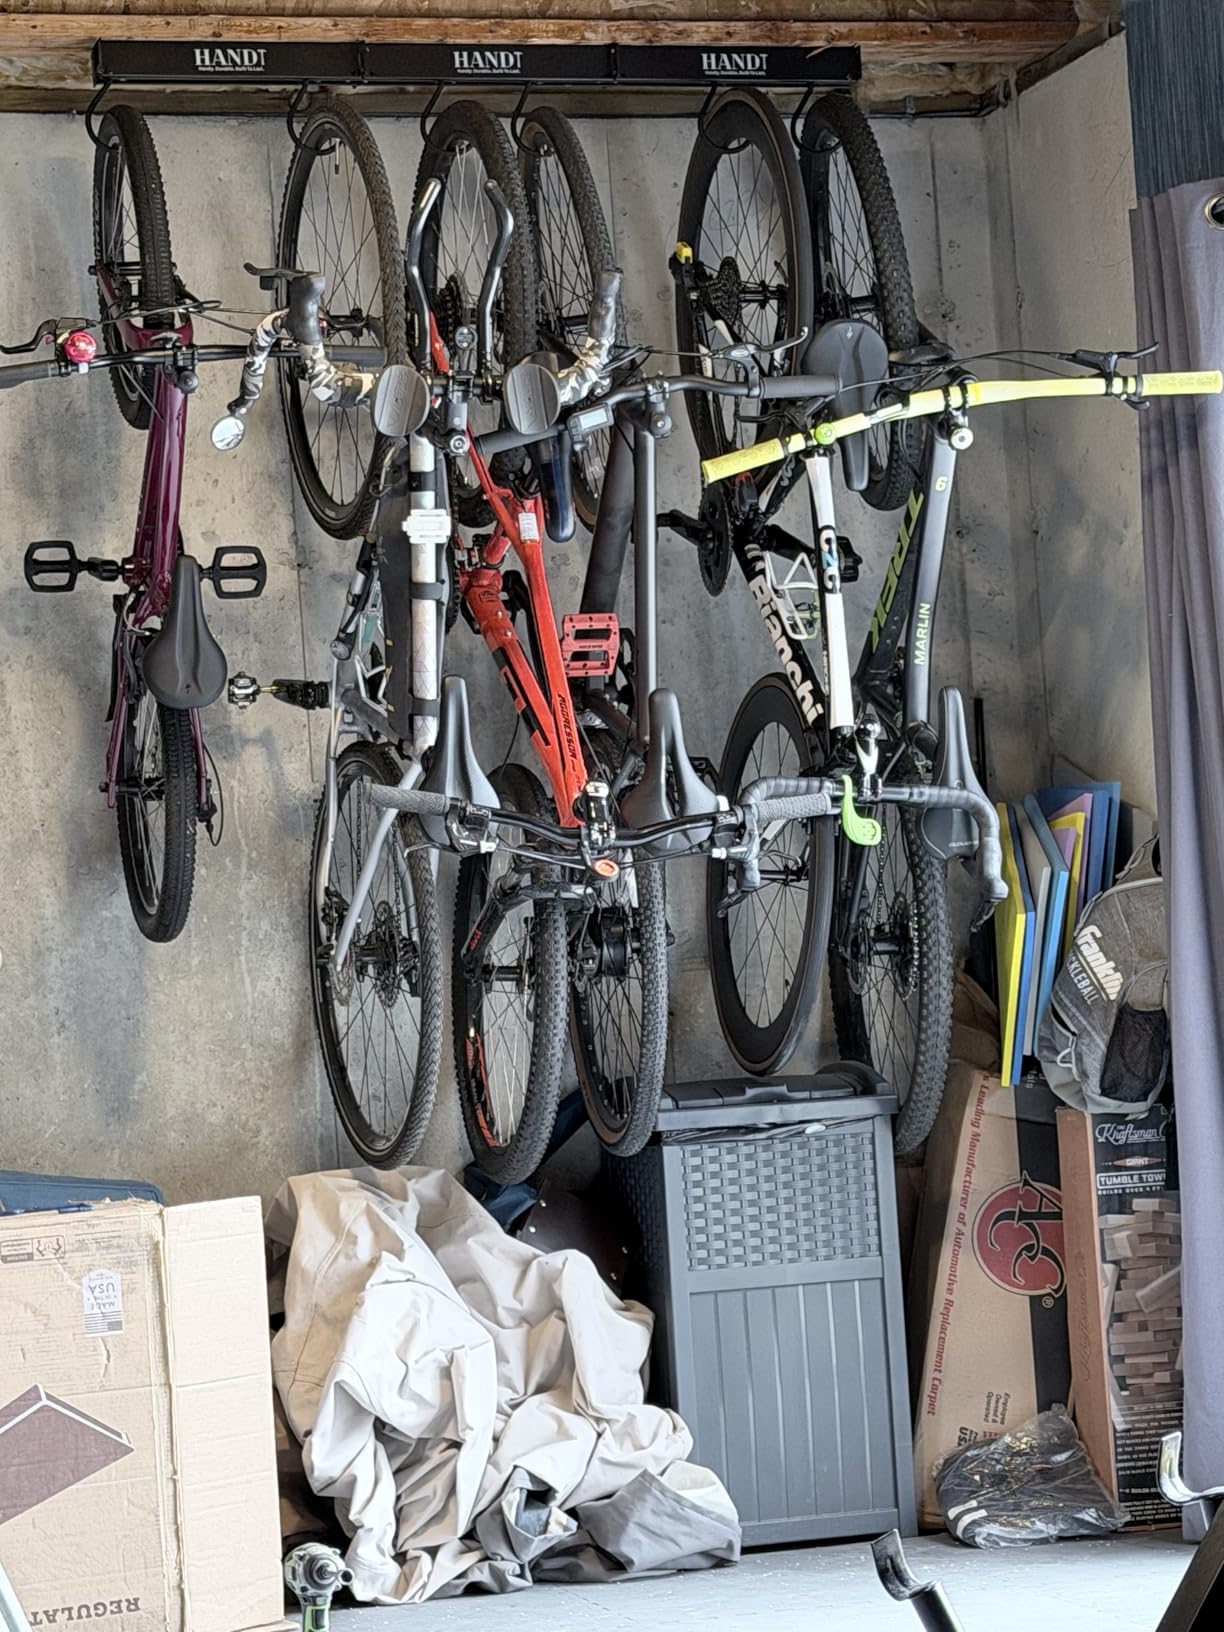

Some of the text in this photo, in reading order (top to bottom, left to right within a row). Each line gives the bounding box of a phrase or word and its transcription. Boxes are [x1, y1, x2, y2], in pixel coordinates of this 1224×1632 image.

[935, 475, 949, 492] 6
[749, 576, 824, 725] Bianchi
[914, 602, 932, 666] MARLIN
[970, 1084, 989, 1130] Leading
[1095, 1123, 1157, 1145] Kraftsman
[958, 1131, 981, 1210] Manufacturer
[1100, 1172, 1166, 1185] TUMBLE TOW
[946, 1227, 965, 1297] Automotive
[88, 1282, 116, 1295] USA
[89, 1301, 116, 1310] MADE
[933, 1298, 954, 1374] Replacement
[927, 1377, 942, 1416] Carpet
